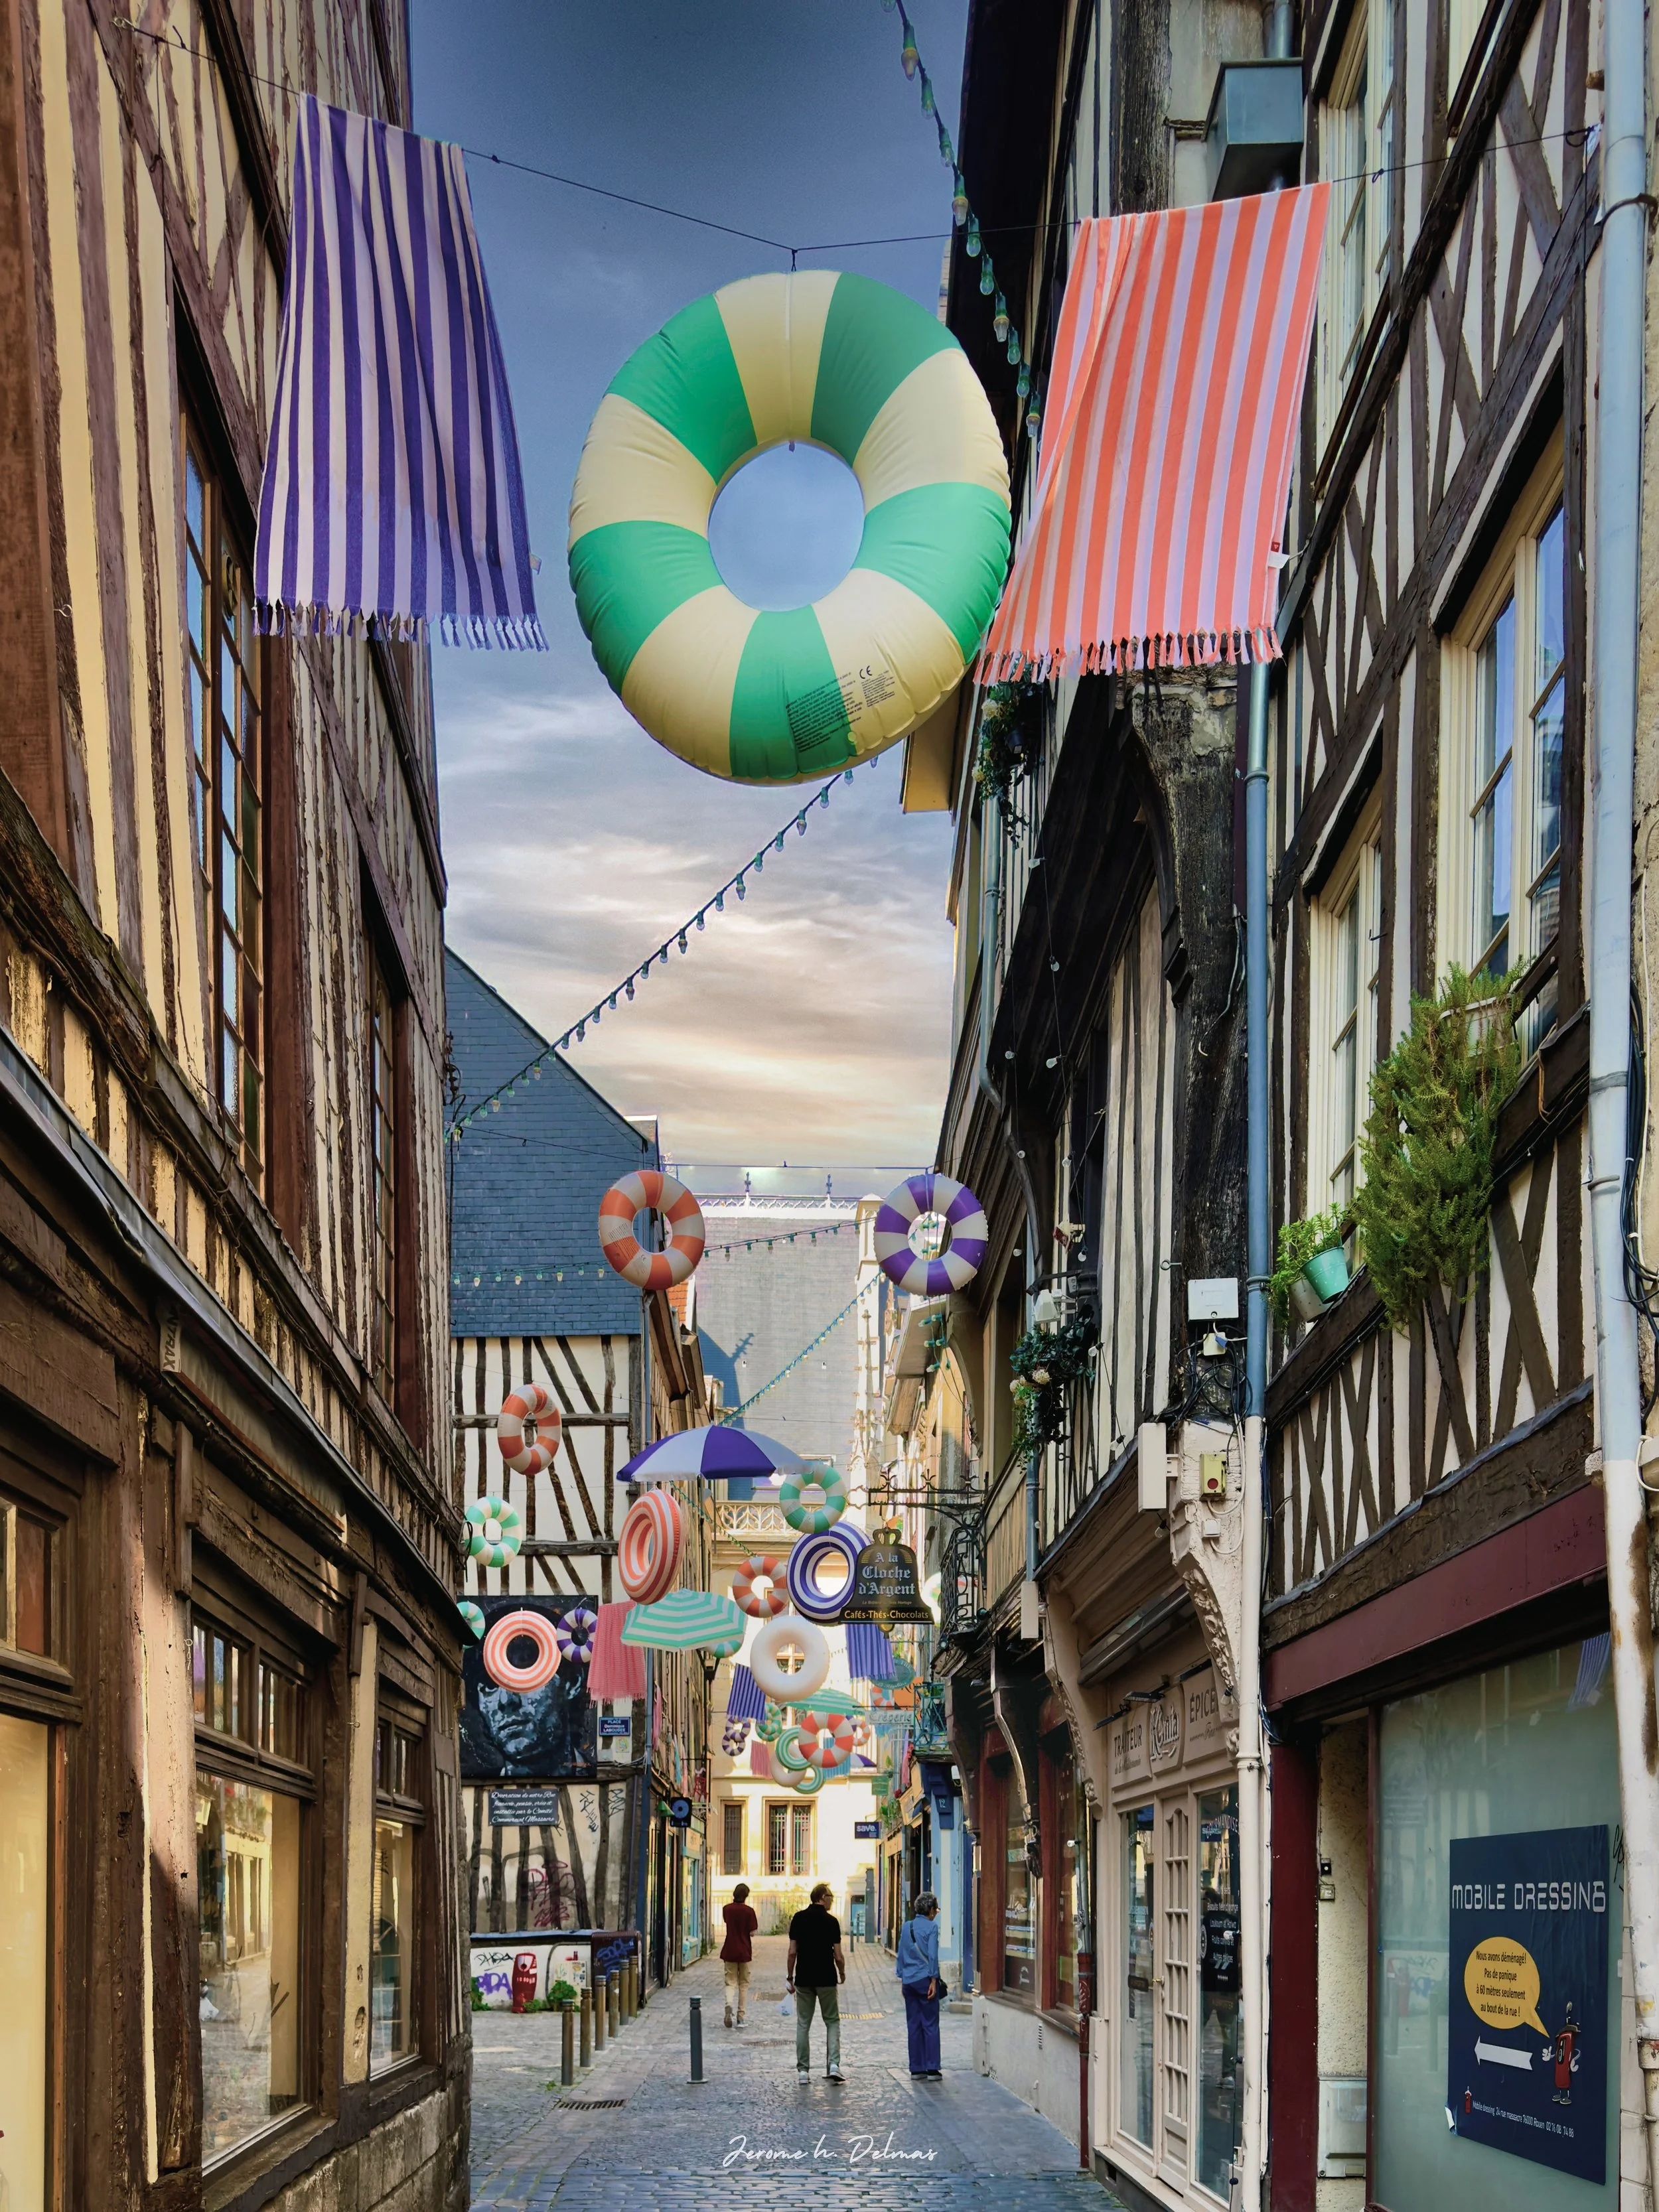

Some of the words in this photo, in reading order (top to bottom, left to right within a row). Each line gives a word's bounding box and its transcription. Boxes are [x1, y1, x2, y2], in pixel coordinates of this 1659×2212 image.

[875, 1552, 885, 1562] A
[889, 1553, 898, 1562] la
[862, 1566, 911, 1581] Cloche
[858, 1582, 915, 1598] d'Argent
[844, 1610, 928, 1619] Cafés-Thés-Chocolats
[1190, 1688, 1219, 1724] ÉPICE
[869, 1712, 912, 1722] Crêperie
[1114, 1724, 1142, 1758] TRAITEUR
[938, 1799, 946, 1808] 12
[1452, 1884, 1506, 1910] MOBILE
[1514, 1881, 1606, 1913] DRESSING
[1476, 1951, 1487, 1961] Nous
[1487, 1953, 1500, 1962] avons
[1492, 1969, 1498, 1979] de
[1498, 1970, 1517, 1982] panique
[1476, 1983, 1479, 1994] à
[1480, 1984, 1485, 1994] 60
[1486, 1986, 1500, 1996] mètres
[1501, 1988, 1526, 2000] seulement
[1486, 2002, 1497, 2014] bout
[1498, 2004, 1503, 2014] de
[1504, 2004, 1508, 2015] la
[1473, 2101, 1482, 2111] Mobile
[1482, 2104, 1495, 2116] dressing
[1496, 2107, 1500, 2116] 24
[1506, 2111, 1522, 2122] massacre
[1522, 2114, 1534, 2126] 76000
[1534, 2117, 1545, 2129] Rouen
[1546, 2121, 1551, 2131] 02
[1556, 2124, 1561, 2134] 08
[1563, 2126, 1568, 2136] 74
[1568, 2128, 1574, 2138] 88
